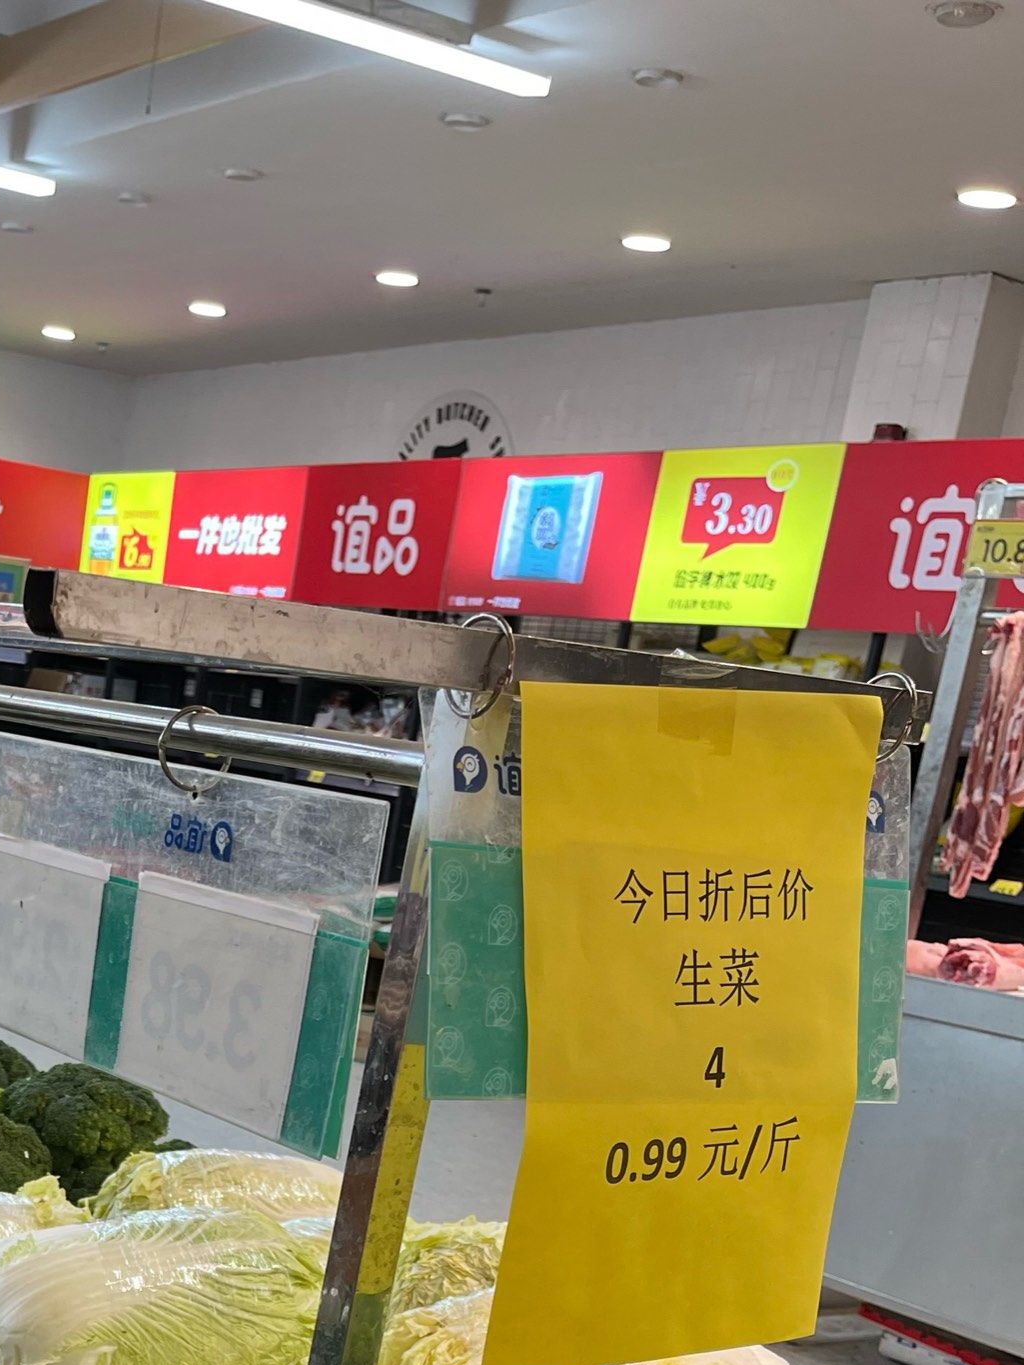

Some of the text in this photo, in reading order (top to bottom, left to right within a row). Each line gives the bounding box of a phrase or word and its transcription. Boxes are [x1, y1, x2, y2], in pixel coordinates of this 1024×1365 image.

[178, 513, 287, 555] 一件也批发
[331, 495, 419, 576] 谊品
[614, 868, 814, 924] 今日折后价
[674, 947, 760, 1007] 生菜
[704, 1046, 725, 1089] 4
[605, 1116, 801, 1184] 0.99 元/斤
